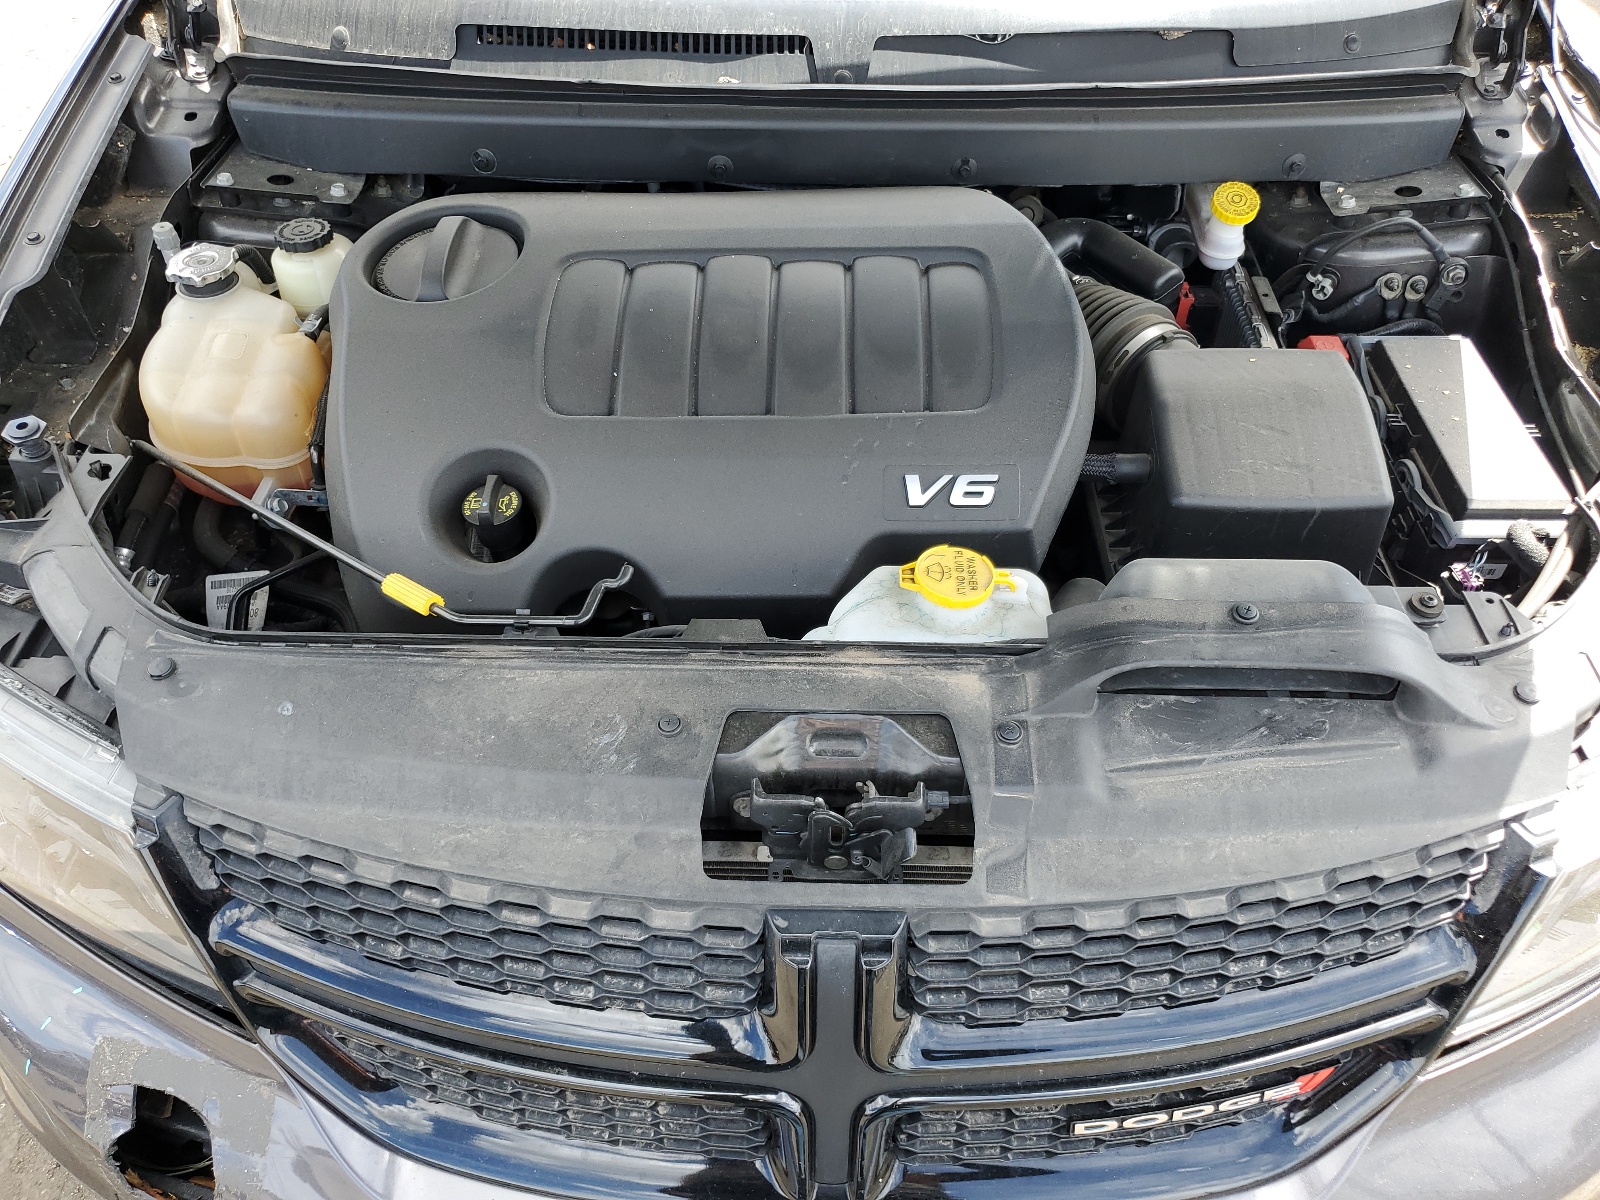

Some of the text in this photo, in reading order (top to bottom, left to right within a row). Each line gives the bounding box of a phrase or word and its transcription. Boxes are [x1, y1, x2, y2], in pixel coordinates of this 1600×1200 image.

[503, 491, 519, 517] ENGINE OIL
[903, 474, 999, 508] V6
[954, 550, 966, 596] FLUID ONLY
[966, 556, 979, 592] WASHER
[1073, 1081, 1303, 1136] DODGE
